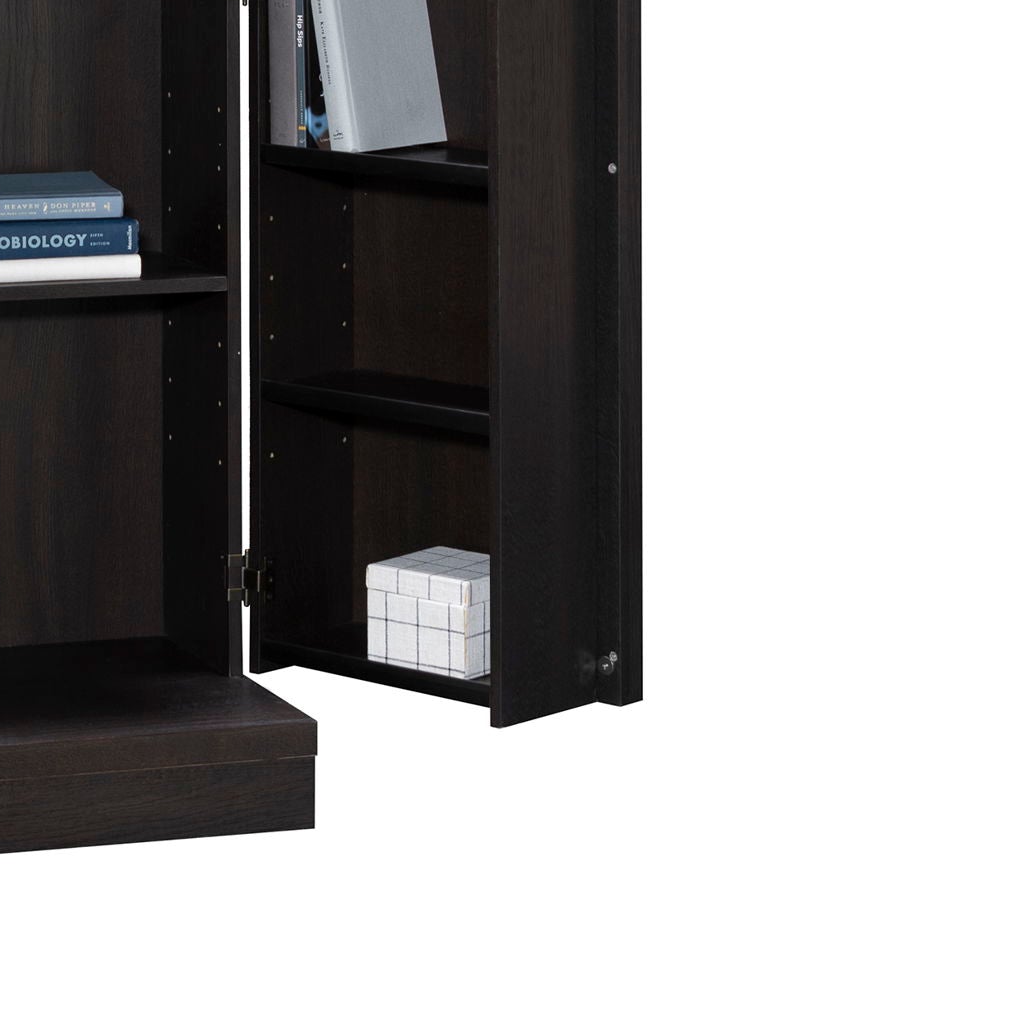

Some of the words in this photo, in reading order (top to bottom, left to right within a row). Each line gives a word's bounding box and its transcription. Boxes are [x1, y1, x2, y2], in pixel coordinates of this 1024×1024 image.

[296, 15, 304, 30] Hip
[296, 30, 304, 48] Sips
[4, 203, 41, 211] HEAVEN
[71, 201, 97, 209] PIPER
